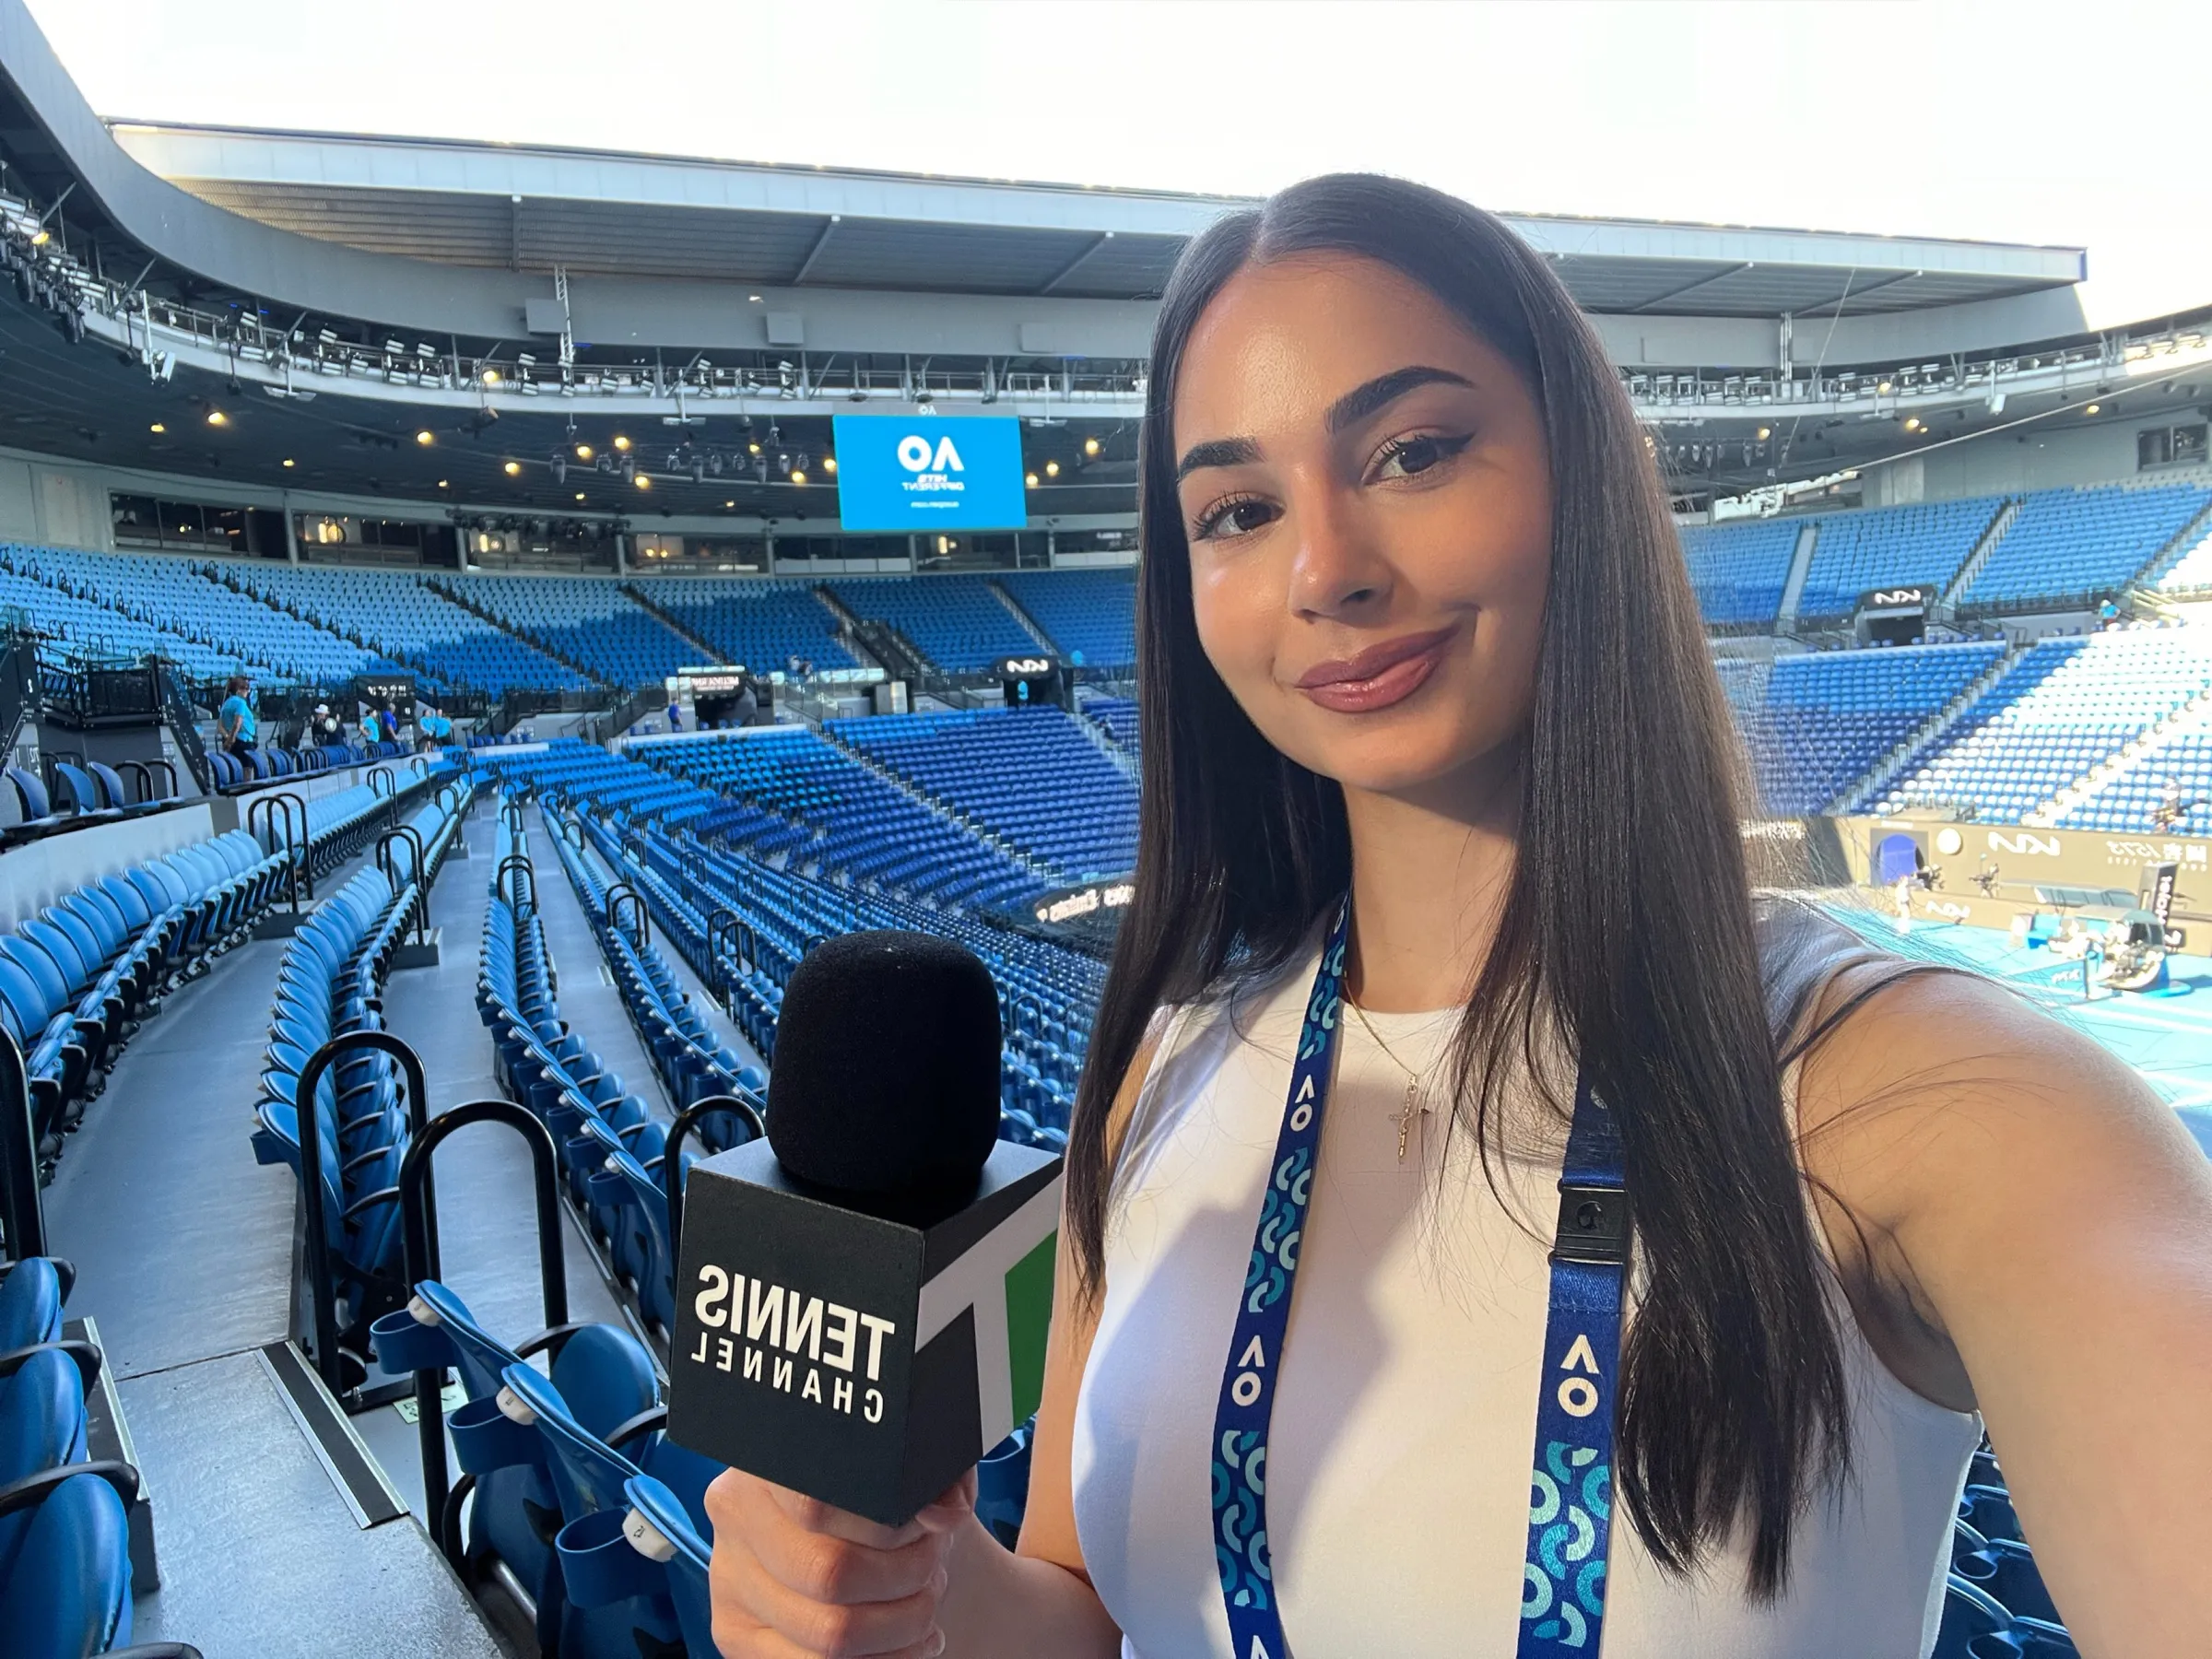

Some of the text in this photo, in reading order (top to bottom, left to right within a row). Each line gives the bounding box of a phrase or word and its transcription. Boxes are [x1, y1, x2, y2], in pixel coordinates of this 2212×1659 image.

[1290, 1075, 1314, 1132] AO
[1230, 1334, 1266, 1406] AO
[1557, 1333, 1599, 1418] AO
